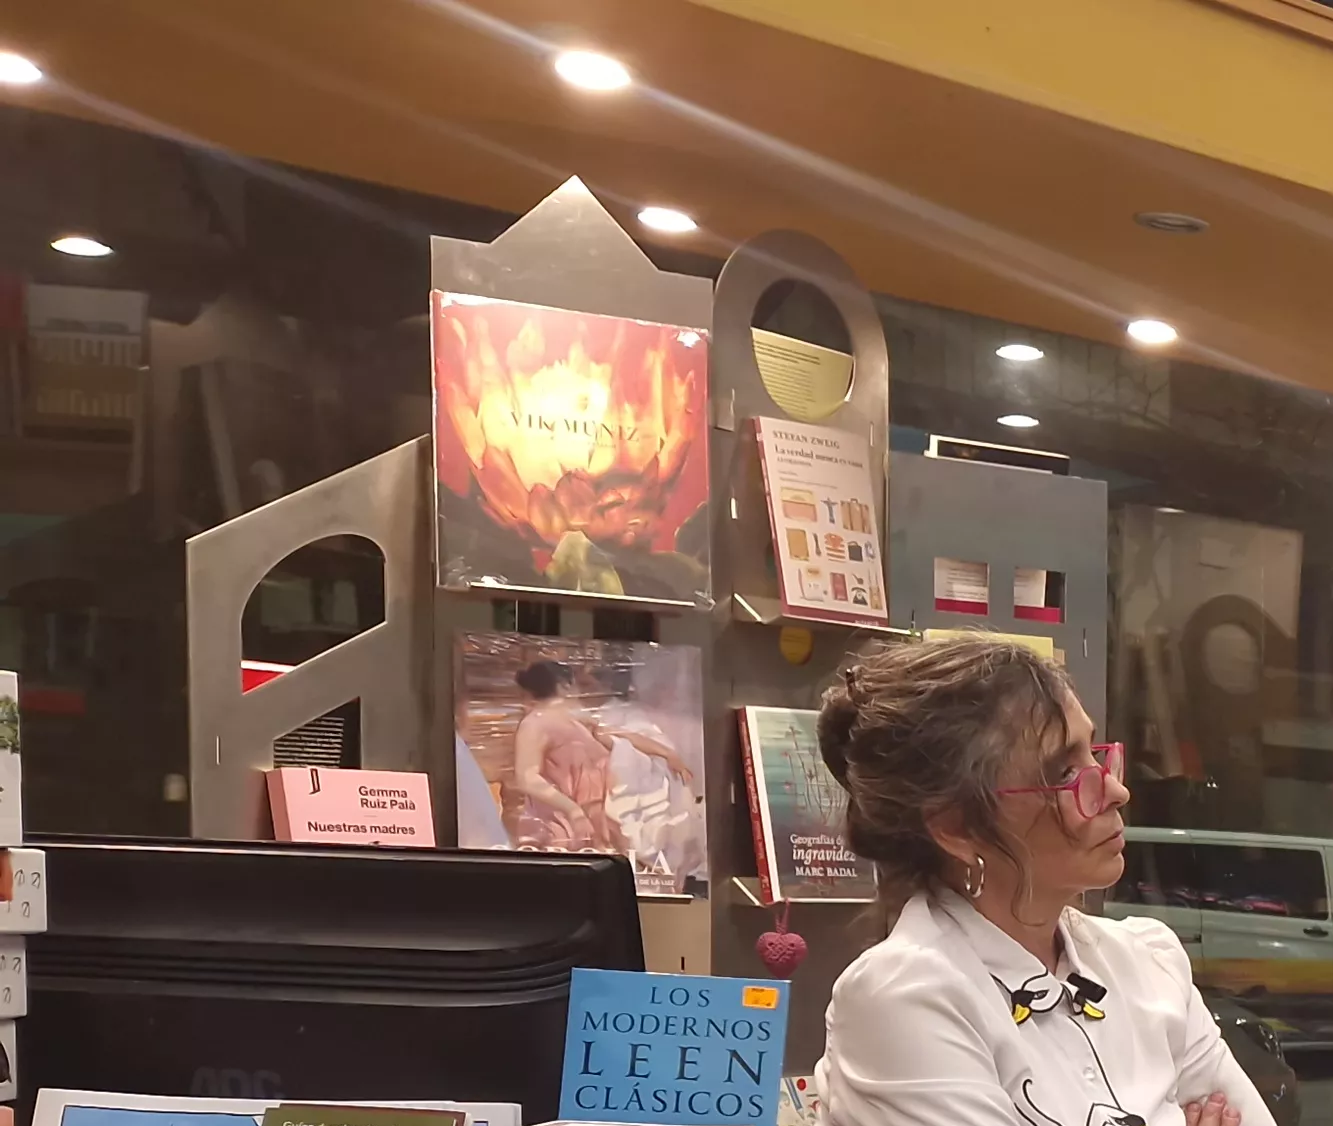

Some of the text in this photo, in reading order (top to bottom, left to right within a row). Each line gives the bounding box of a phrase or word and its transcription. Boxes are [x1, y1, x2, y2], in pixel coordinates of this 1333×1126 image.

[510, 411, 548, 431] VIK
[772, 430, 840, 449] STEFAN ZWEIG
[358, 786, 407, 798] Gemma
[361, 798, 416, 810] Ruiz Palà
[307, 821, 415, 835] Nuestras madres
[790, 834, 834, 846] Geografías
[792, 846, 858, 862] ingravidez
[796, 866, 857, 877] MARC BADAL
[651, 987, 710, 1007] LOS
[581, 1011, 771, 1041] MODERNOS
[578, 1041, 767, 1085] LEEN
[575, 1082, 763, 1118] CLÁSICOS
